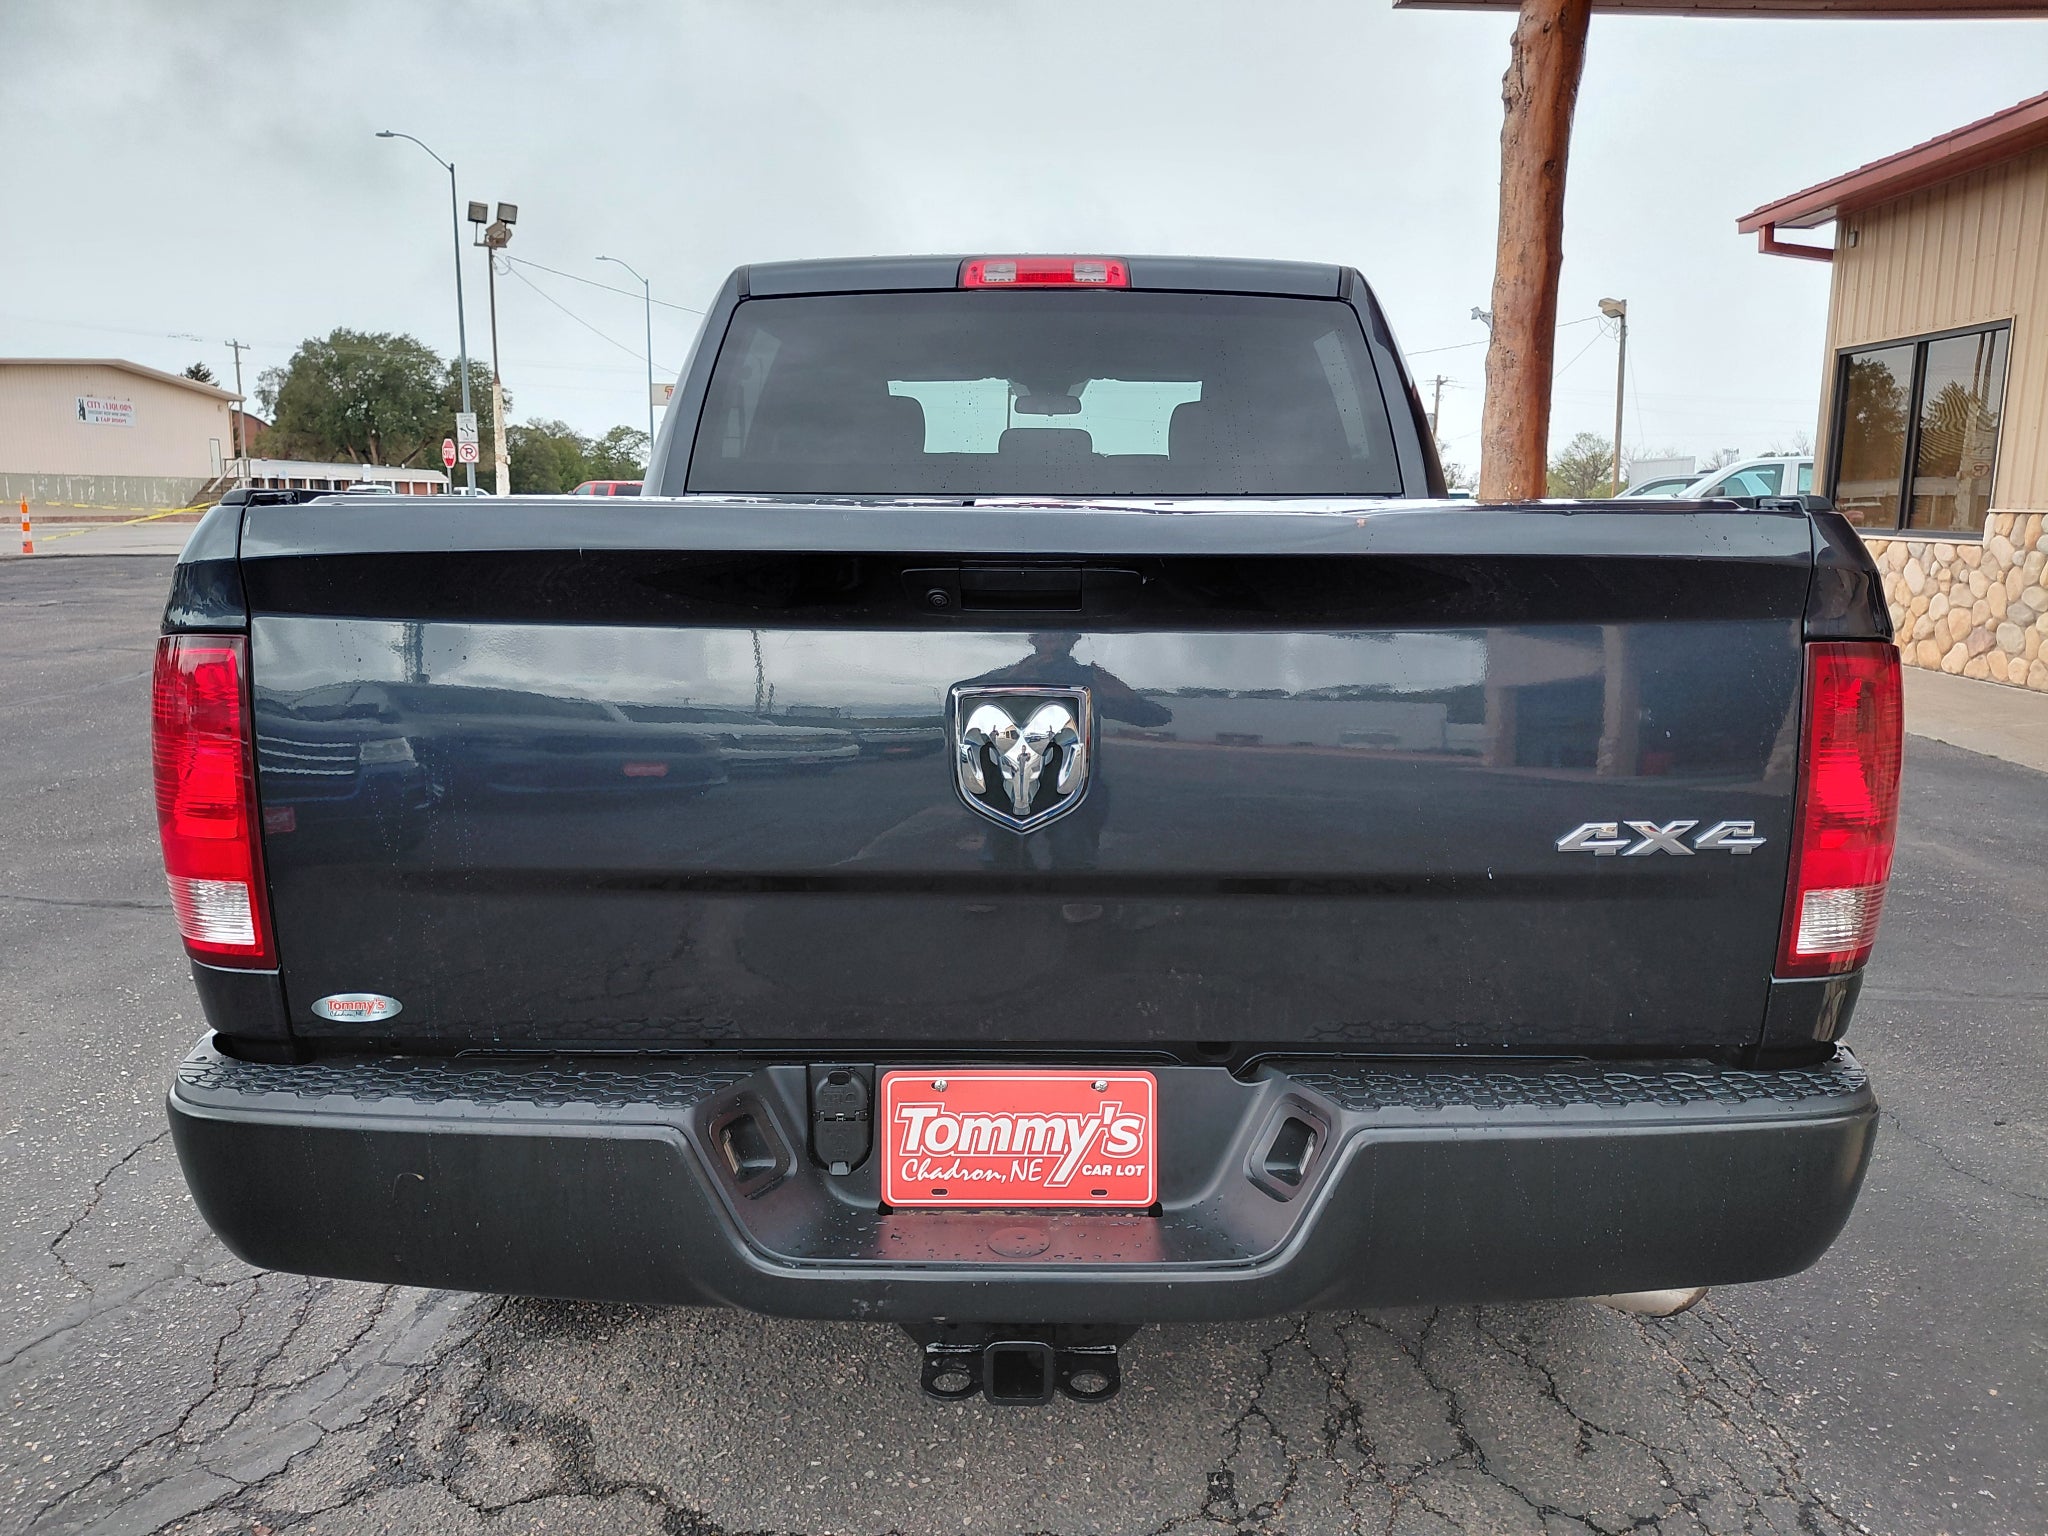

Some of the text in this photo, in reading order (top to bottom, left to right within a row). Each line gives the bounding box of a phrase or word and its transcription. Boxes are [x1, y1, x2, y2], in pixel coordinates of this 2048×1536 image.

[86, 400, 101, 409] CITY
[325, 997, 386, 1016] Tommy's
[894, 1101, 1146, 1187] Tommy's
[901, 1158, 1043, 1183] Chadron, NE
[1082, 1164, 1145, 1177] CAR LOT
